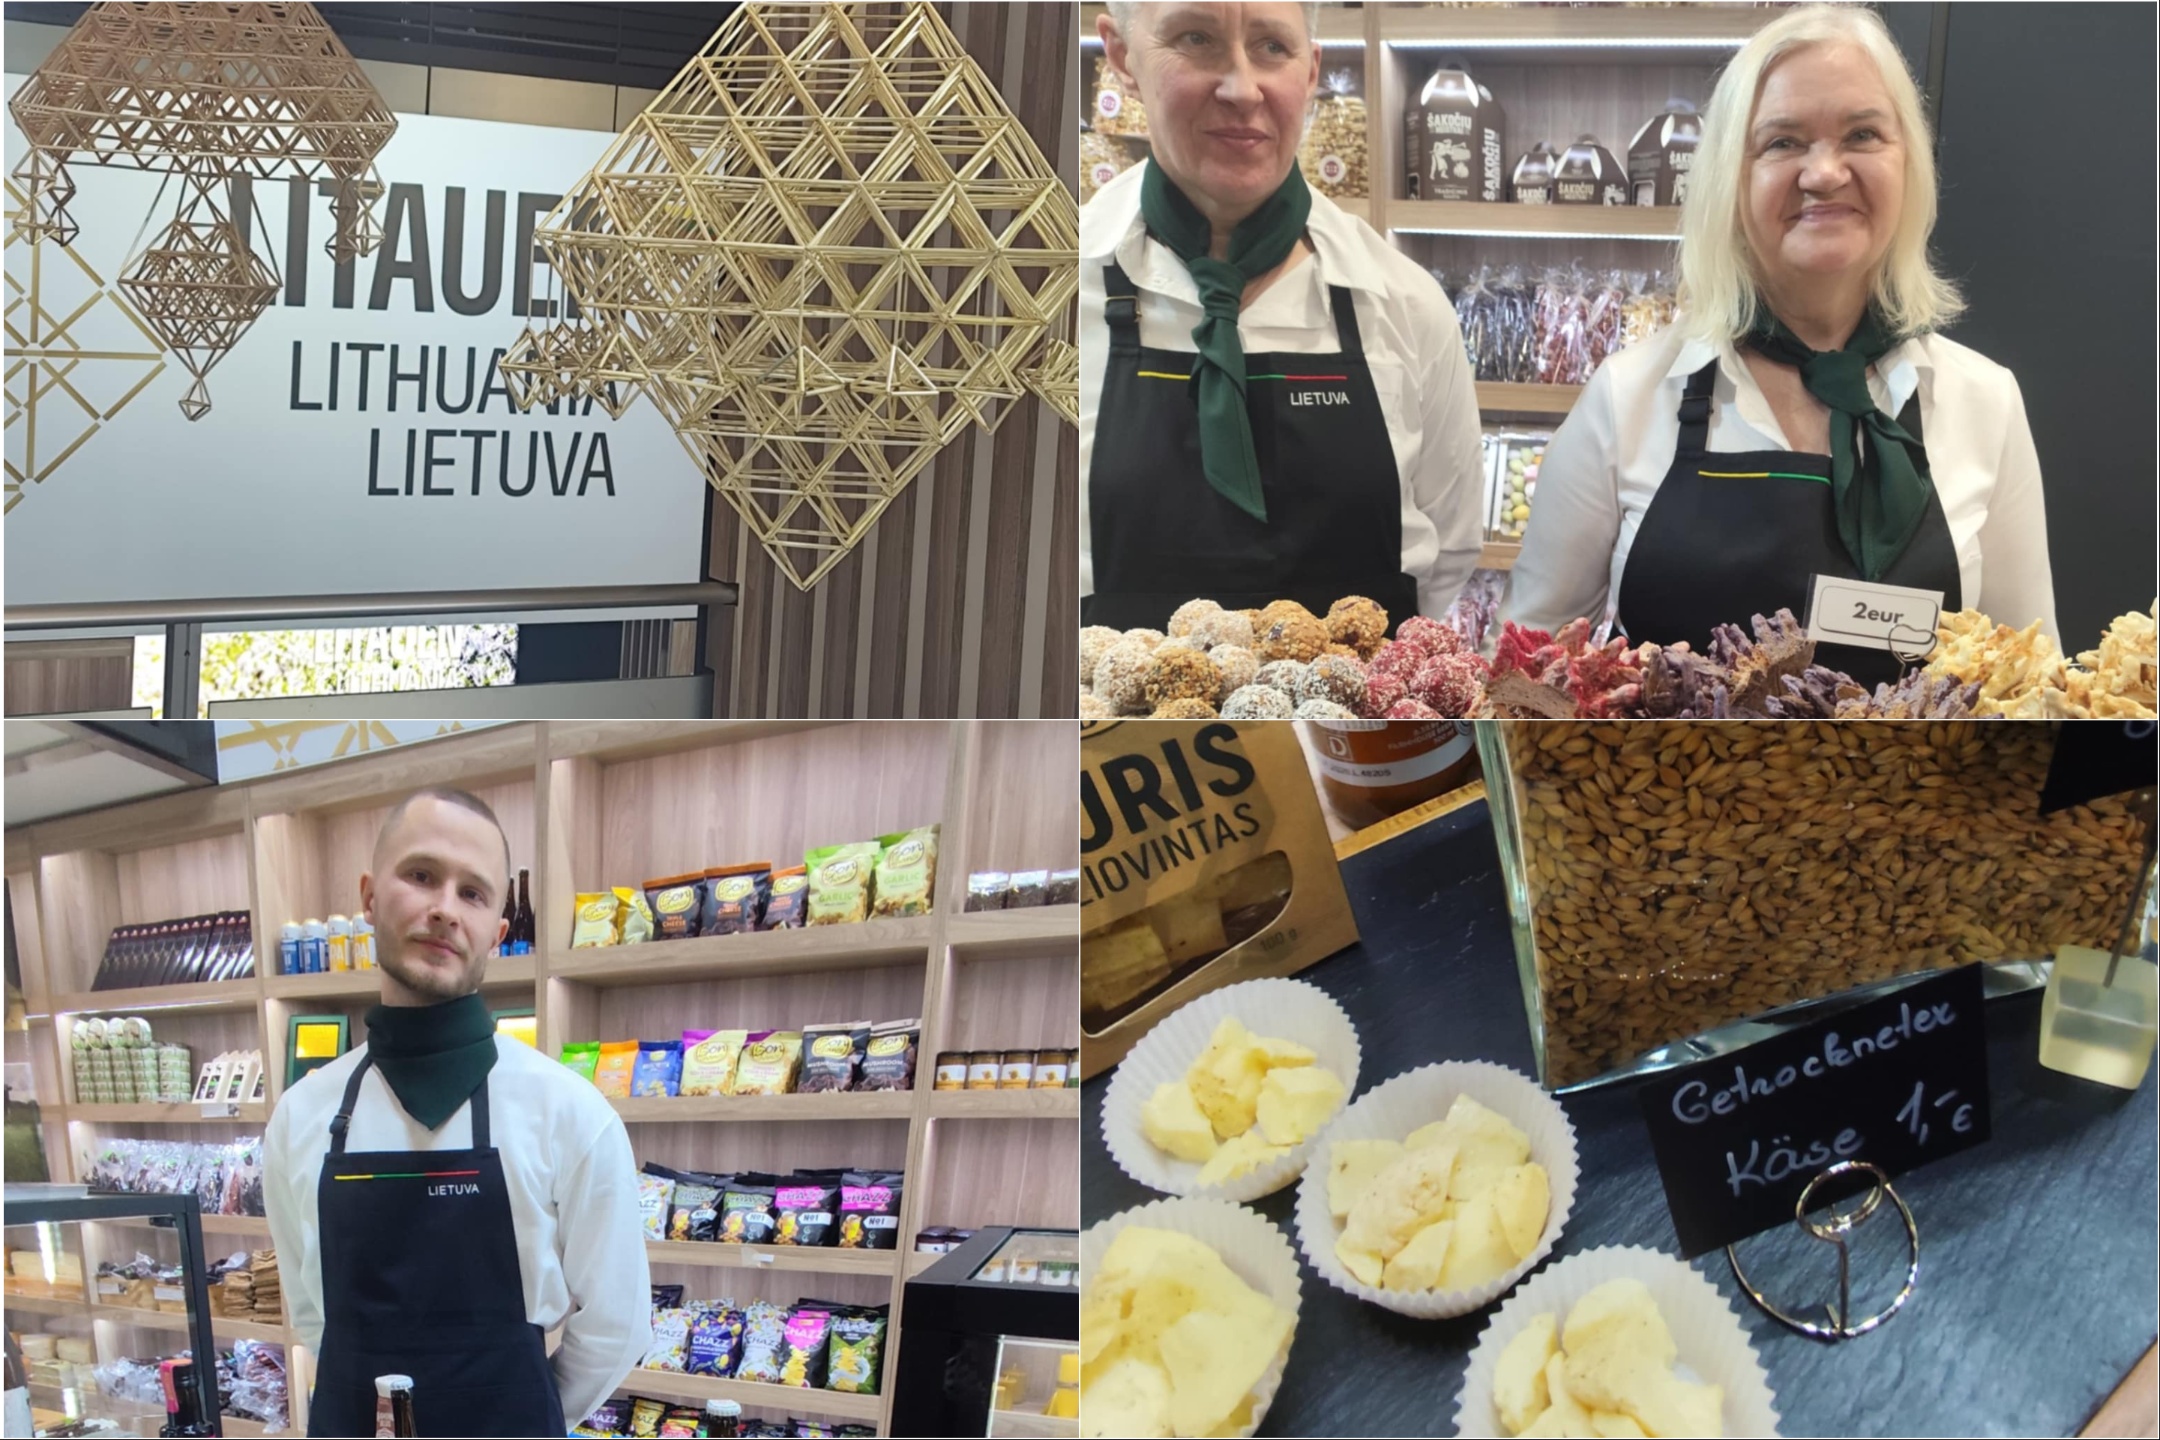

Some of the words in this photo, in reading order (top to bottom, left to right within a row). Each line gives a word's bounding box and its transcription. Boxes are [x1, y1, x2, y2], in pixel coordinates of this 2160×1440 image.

[290, 340, 618, 417] LITHUANIA
[1290, 391, 1351, 406] LIETUVA
[368, 428, 616, 497] LIETUVA
[1852, 601, 1904, 624] 2eur
[1081, 803, 1260, 906] IOVINTAS
[1726, 1128, 1862, 1197] Käse
[428, 1183, 480, 1196] LIETUVA
[692, 1335, 730, 1348] CHAZZ
